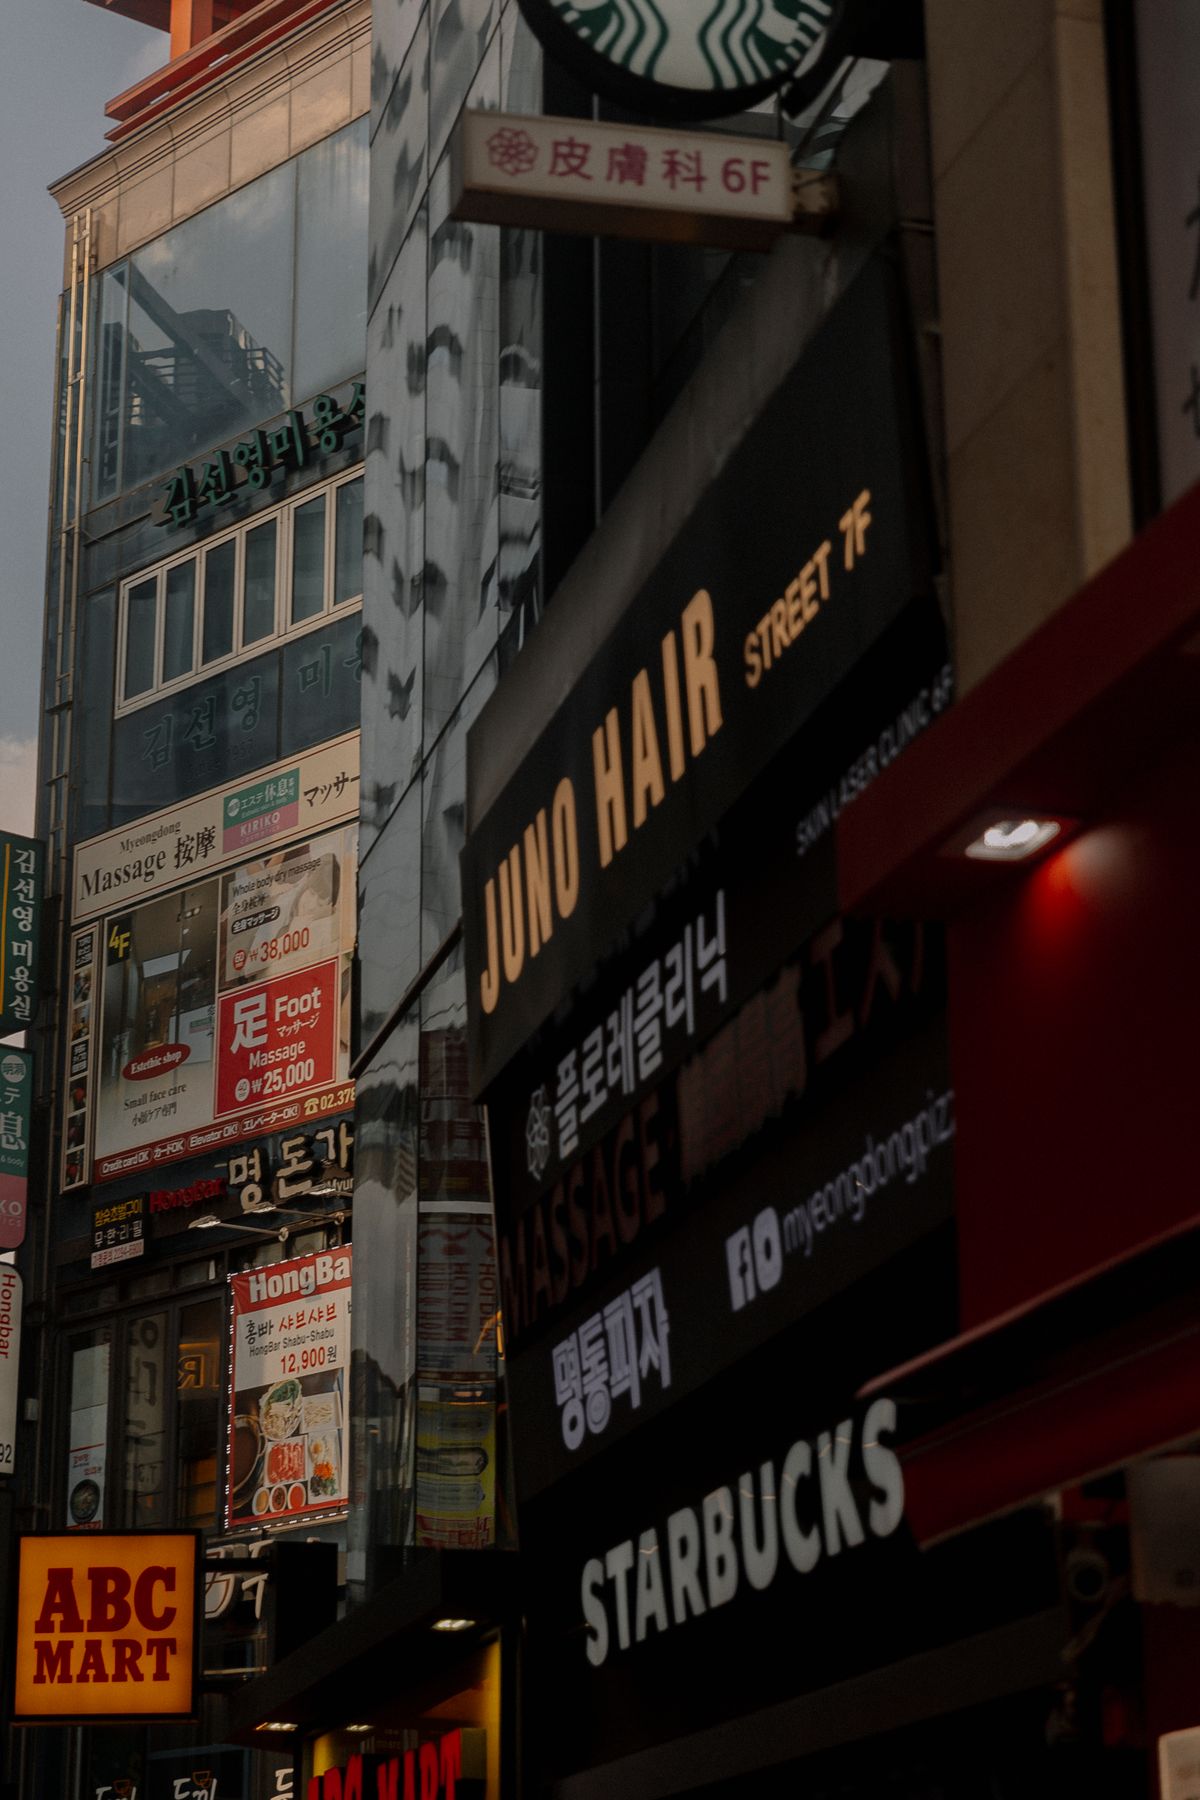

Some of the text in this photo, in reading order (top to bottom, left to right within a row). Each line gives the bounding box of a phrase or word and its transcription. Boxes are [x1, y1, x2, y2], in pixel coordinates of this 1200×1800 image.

[548, 137, 770, 195] 皮膚科 6F
[480, 488, 872, 1014] JUNO HAIR STREET 7F
[120, 821, 181, 853] Myeongdong
[240, 811, 280, 837] KIRIKO
[80, 825, 216, 901] Massage 按摩
[9, 849, 36, 1022] 김선영 미용실
[108, 925, 130, 959] 4F
[230, 992, 268, 1055] 足
[274, 986, 321, 1022] Foot
[554, 888, 728, 1161] 플로레클리닉
[249, 1040, 305, 1070] Massage
[149, 1090, 166, 1103] face
[168, 1084, 186, 1097] care
[248, 1255, 352, 1303] HongBa
[279, 1302, 337, 1332] 샤브샤브
[249, 1327, 335, 1358] HongBar Shabu-Shabu
[551, 1266, 671, 1450] 명동피자
[581, 1397, 905, 1667] STARBUCKS
[34, 1566, 178, 1634] ABC
[32, 1637, 178, 1685] MART
